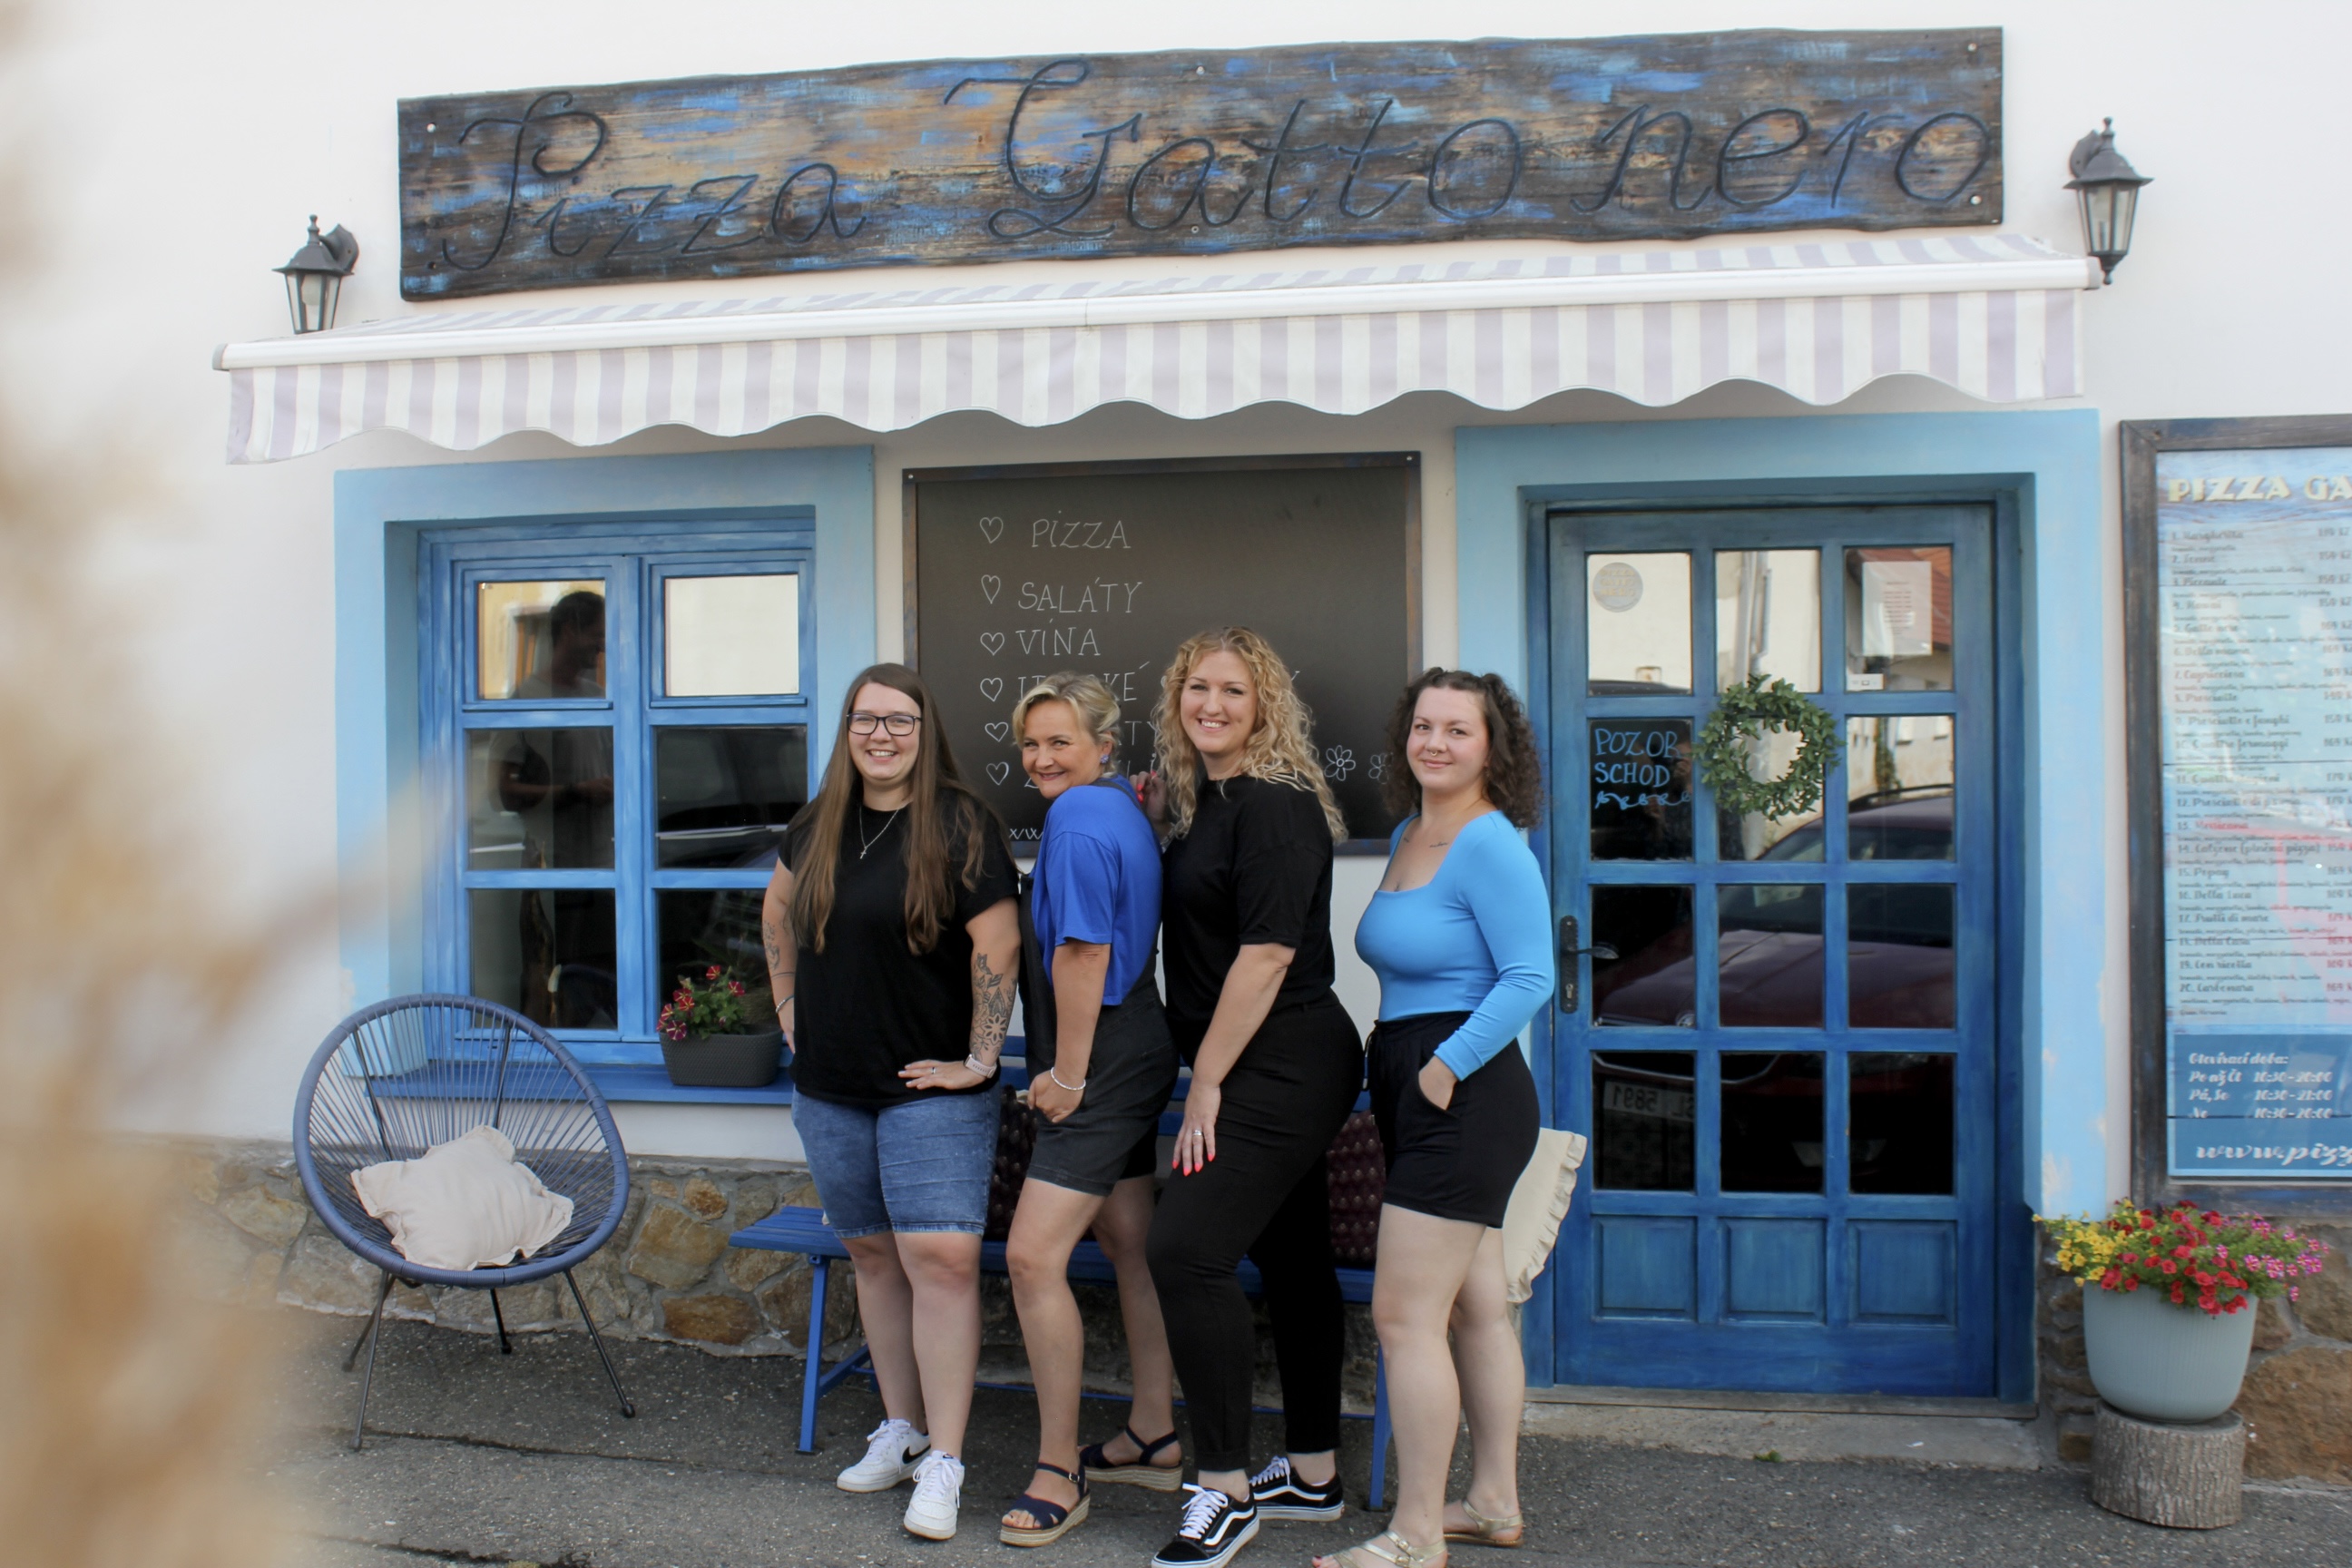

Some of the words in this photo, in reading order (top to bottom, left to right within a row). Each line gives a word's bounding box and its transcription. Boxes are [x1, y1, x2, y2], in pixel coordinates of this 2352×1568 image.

[443, 91, 867, 270] Pizza
[944, 59, 1522, 238] Gatto
[1570, 103, 1992, 211] nero
[2169, 476, 2291, 503] PIZZA
[1017, 576, 1143, 613] SALÁTY
[1014, 618, 1102, 656] VÍNA
[1594, 728, 1681, 759] POZOR
[1594, 762, 1671, 788] SCHOD
